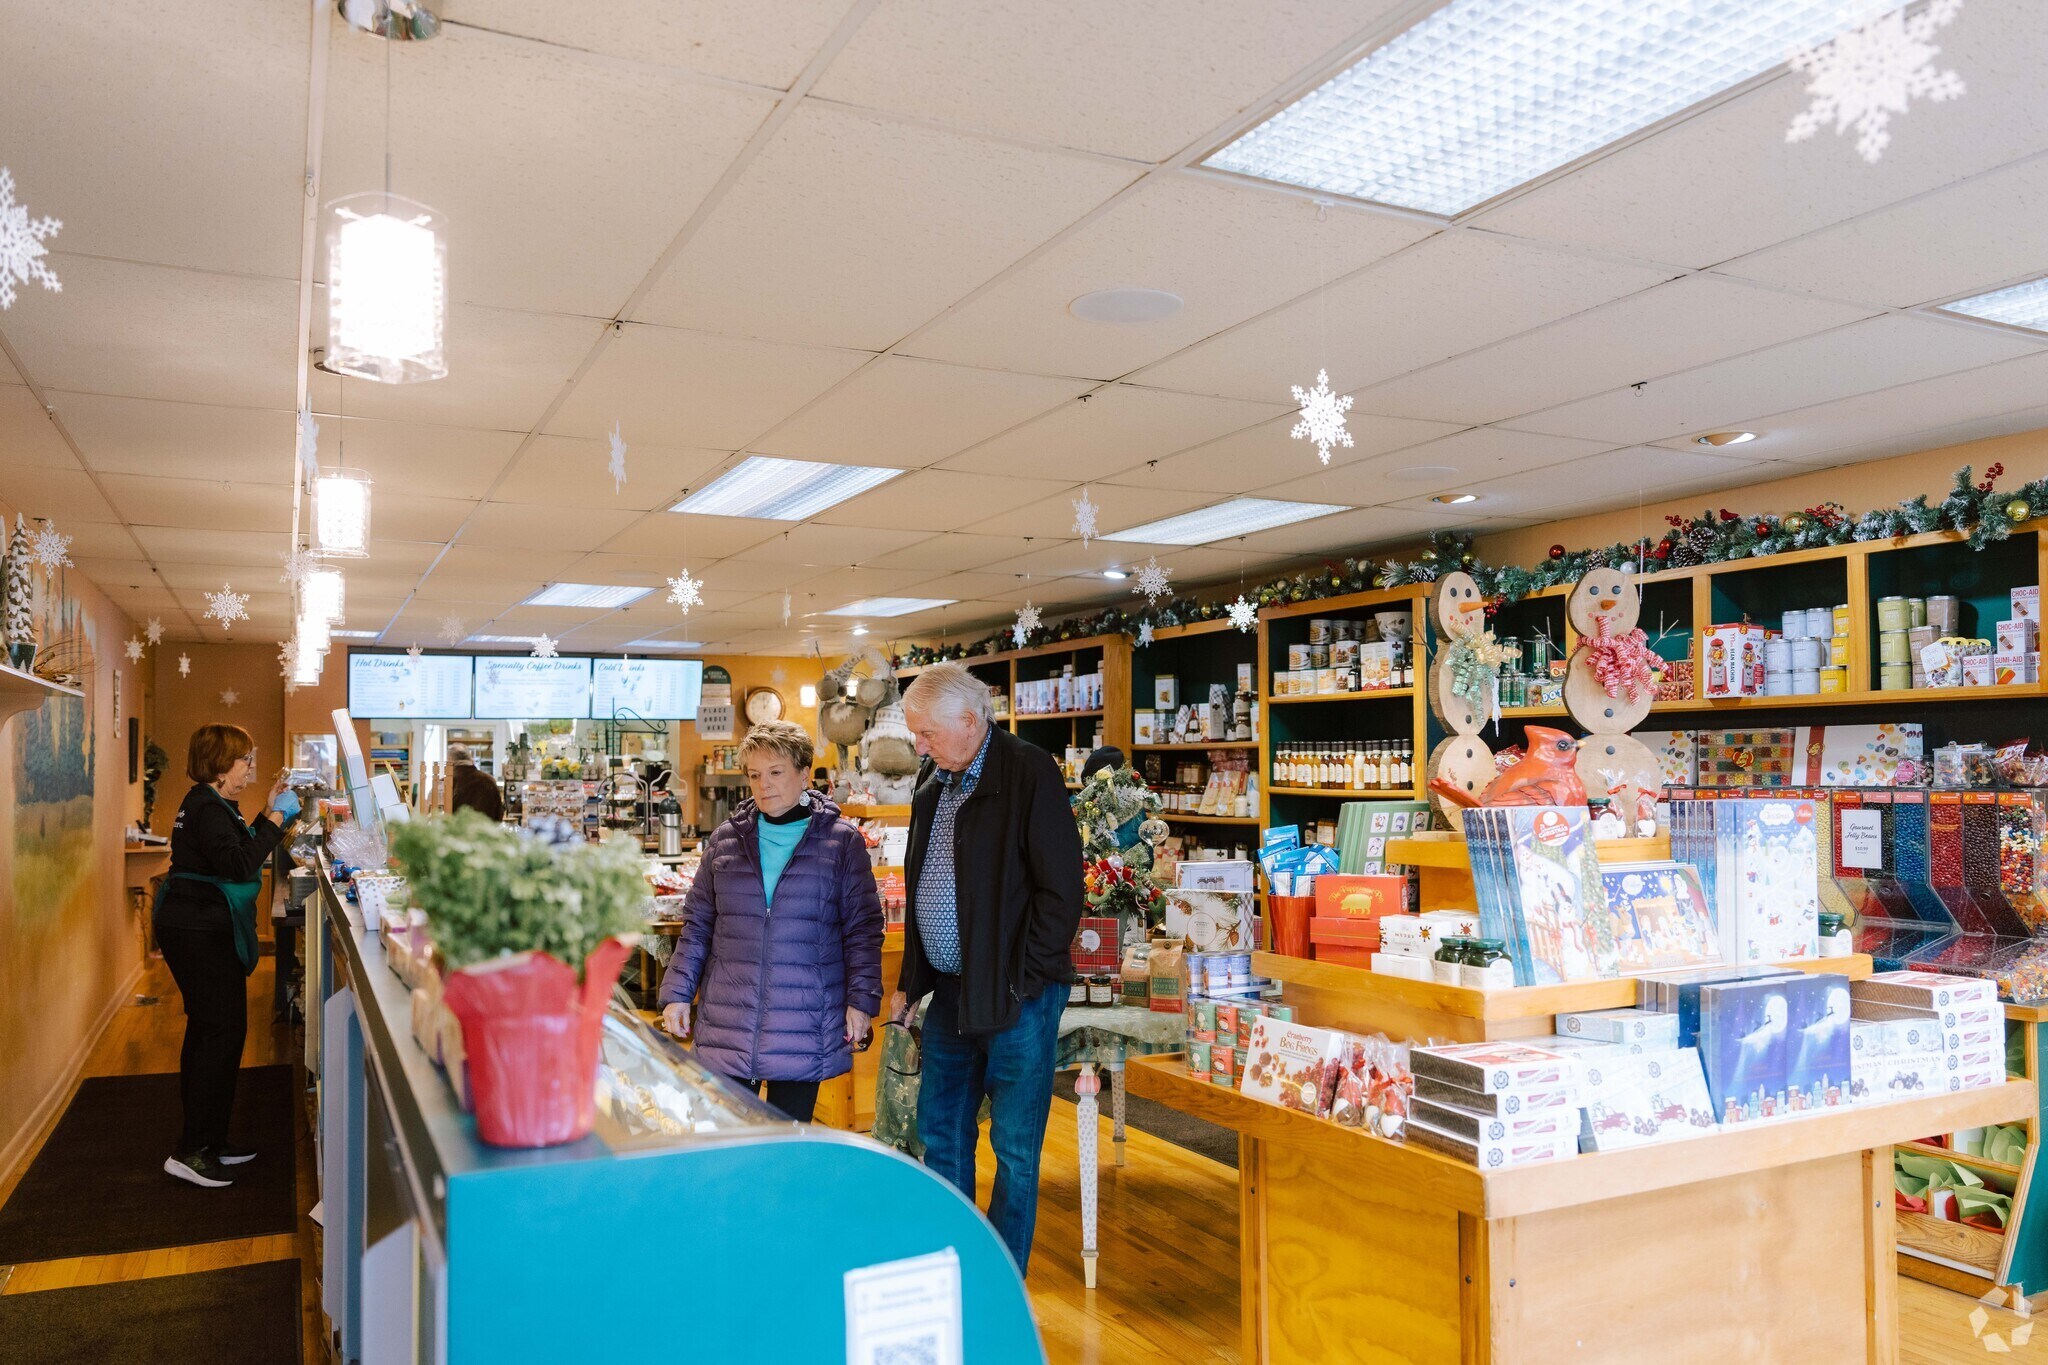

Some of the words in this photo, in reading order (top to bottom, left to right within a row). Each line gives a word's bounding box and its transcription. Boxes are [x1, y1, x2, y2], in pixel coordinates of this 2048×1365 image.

[2011, 588, 2039, 598] CHOC-AID
[1997, 622, 2024, 631] CHOC-AID
[355, 659, 372, 667] Hot
[374, 659, 404, 667] Drinks
[1963, 657, 1988, 667] CHOC-AID
[1994, 656, 2023, 664] GUMI-AID
[486, 661, 525, 671] Specialty
[526, 661, 552, 671] Coffee
[554, 661, 582, 670] Drinks
[598, 663, 617, 671] Cold
[1542, 688, 1562, 702] DOT
[1845, 832, 1860, 840] Jelly
[1287, 1030, 1312, 1043] Cranberry
